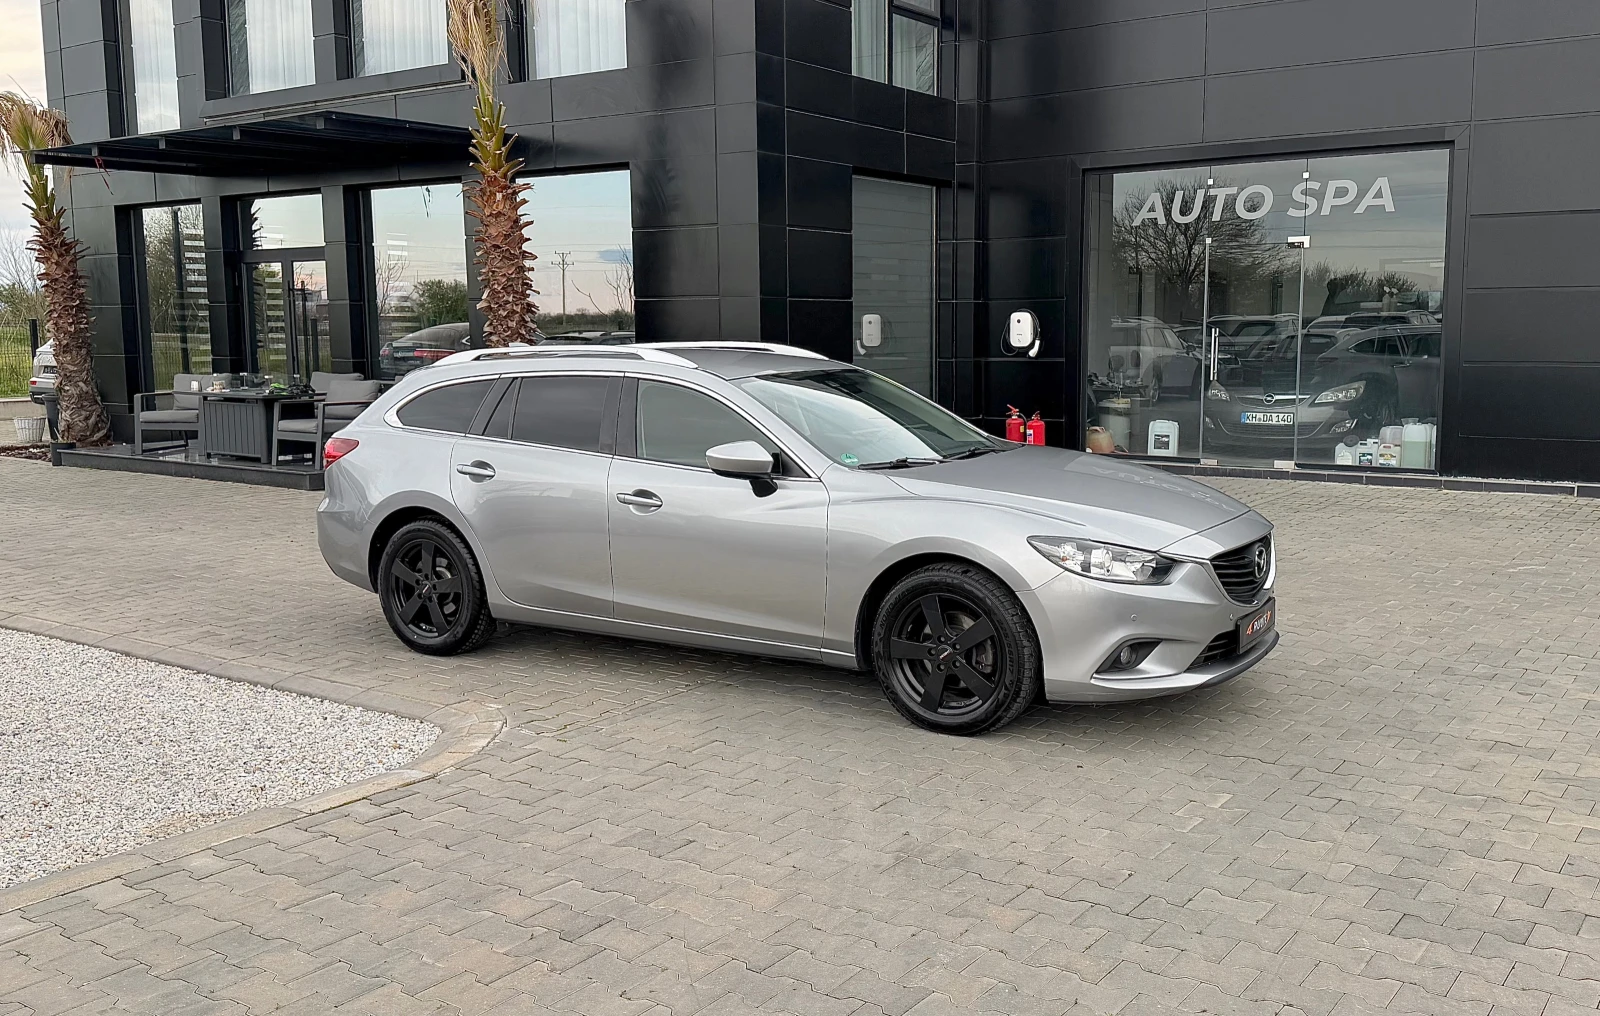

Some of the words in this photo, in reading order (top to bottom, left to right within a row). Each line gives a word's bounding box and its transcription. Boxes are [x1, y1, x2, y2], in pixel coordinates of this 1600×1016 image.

[1131, 184, 1274, 226] AUTO
[1286, 177, 1396, 217] SPA
[1245, 413, 1257, 422] KH
[1262, 414, 1273, 423] DA
[1275, 414, 1292, 423] 140
